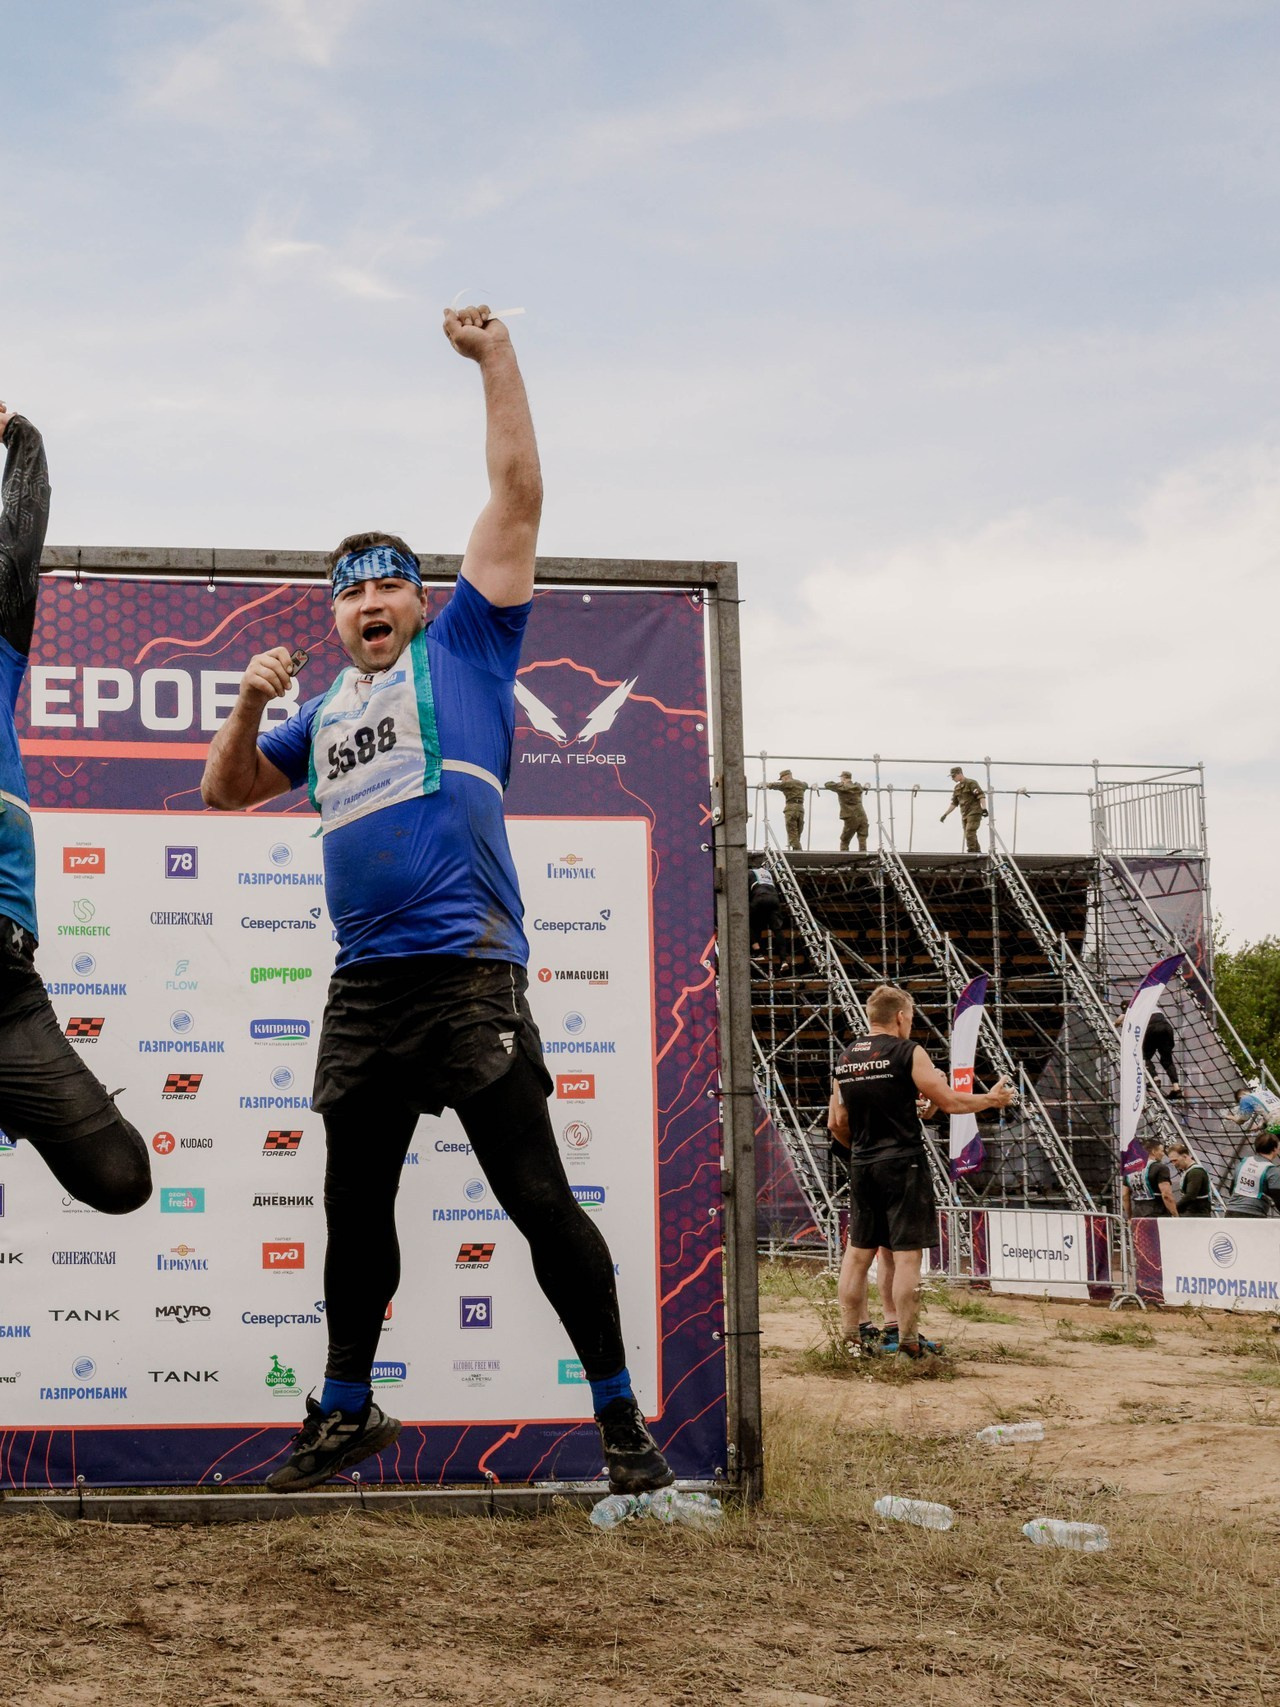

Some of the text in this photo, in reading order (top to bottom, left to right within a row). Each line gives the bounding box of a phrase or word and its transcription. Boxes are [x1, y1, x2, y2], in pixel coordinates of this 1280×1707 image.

[327, 716, 397, 780] 5588
[520, 752, 627, 765] ЛИГА ГЕРОЕВ
[342, 778, 392, 806] ГАЗПРОМБАНК
[171, 853, 193, 872] 78
[238, 872, 323, 886] ГАЗПРОМБАНК
[150, 911, 213, 926] СЕНЕЖСКАЯ
[241, 916, 317, 932] Северсталь
[57, 925, 111, 937] SYNERGETIC
[533, 918, 607, 934] Северсталь
[250, 967, 312, 984] GROWFOOD
[554, 970, 609, 980] YAMAGUCHI
[166, 980, 198, 990] FLOW
[254, 1023, 307, 1035] КИПРИНО
[138, 1040, 225, 1053] ГАЗПРОМБАНК
[540, 1041, 616, 1054] АЗПРОМБАНК
[240, 1096, 314, 1109] ГАЗПРОМБА
[180, 1137, 213, 1149] KUDAGO
[434, 1140, 474, 1156] Север
[252, 1195, 314, 1207] ДНЕВНИК
[573, 1190, 601, 1200] РИНО
[168, 1196, 194, 1208] fresh
[433, 1208, 508, 1221] ГАЗПРОМБАН
[52, 1251, 116, 1265] СЕНЕЖСКАЯ
[1001, 1243, 1070, 1263] Северсталь
[1176, 1275, 1279, 1300] ГАЗПРОМБАНК
[48, 1309, 120, 1321] TANK
[155, 1305, 211, 1318] МАГУРО
[465, 1303, 487, 1322] 78
[241, 1311, 321, 1327] Северсталь
[474, 1360, 487, 1370] FREE
[487, 1360, 500, 1370] WINE
[148, 1370, 219, 1382] TANK
[266, 1375, 297, 1385] bionova
[40, 1387, 127, 1399] ГАЗПРОМБАНК
